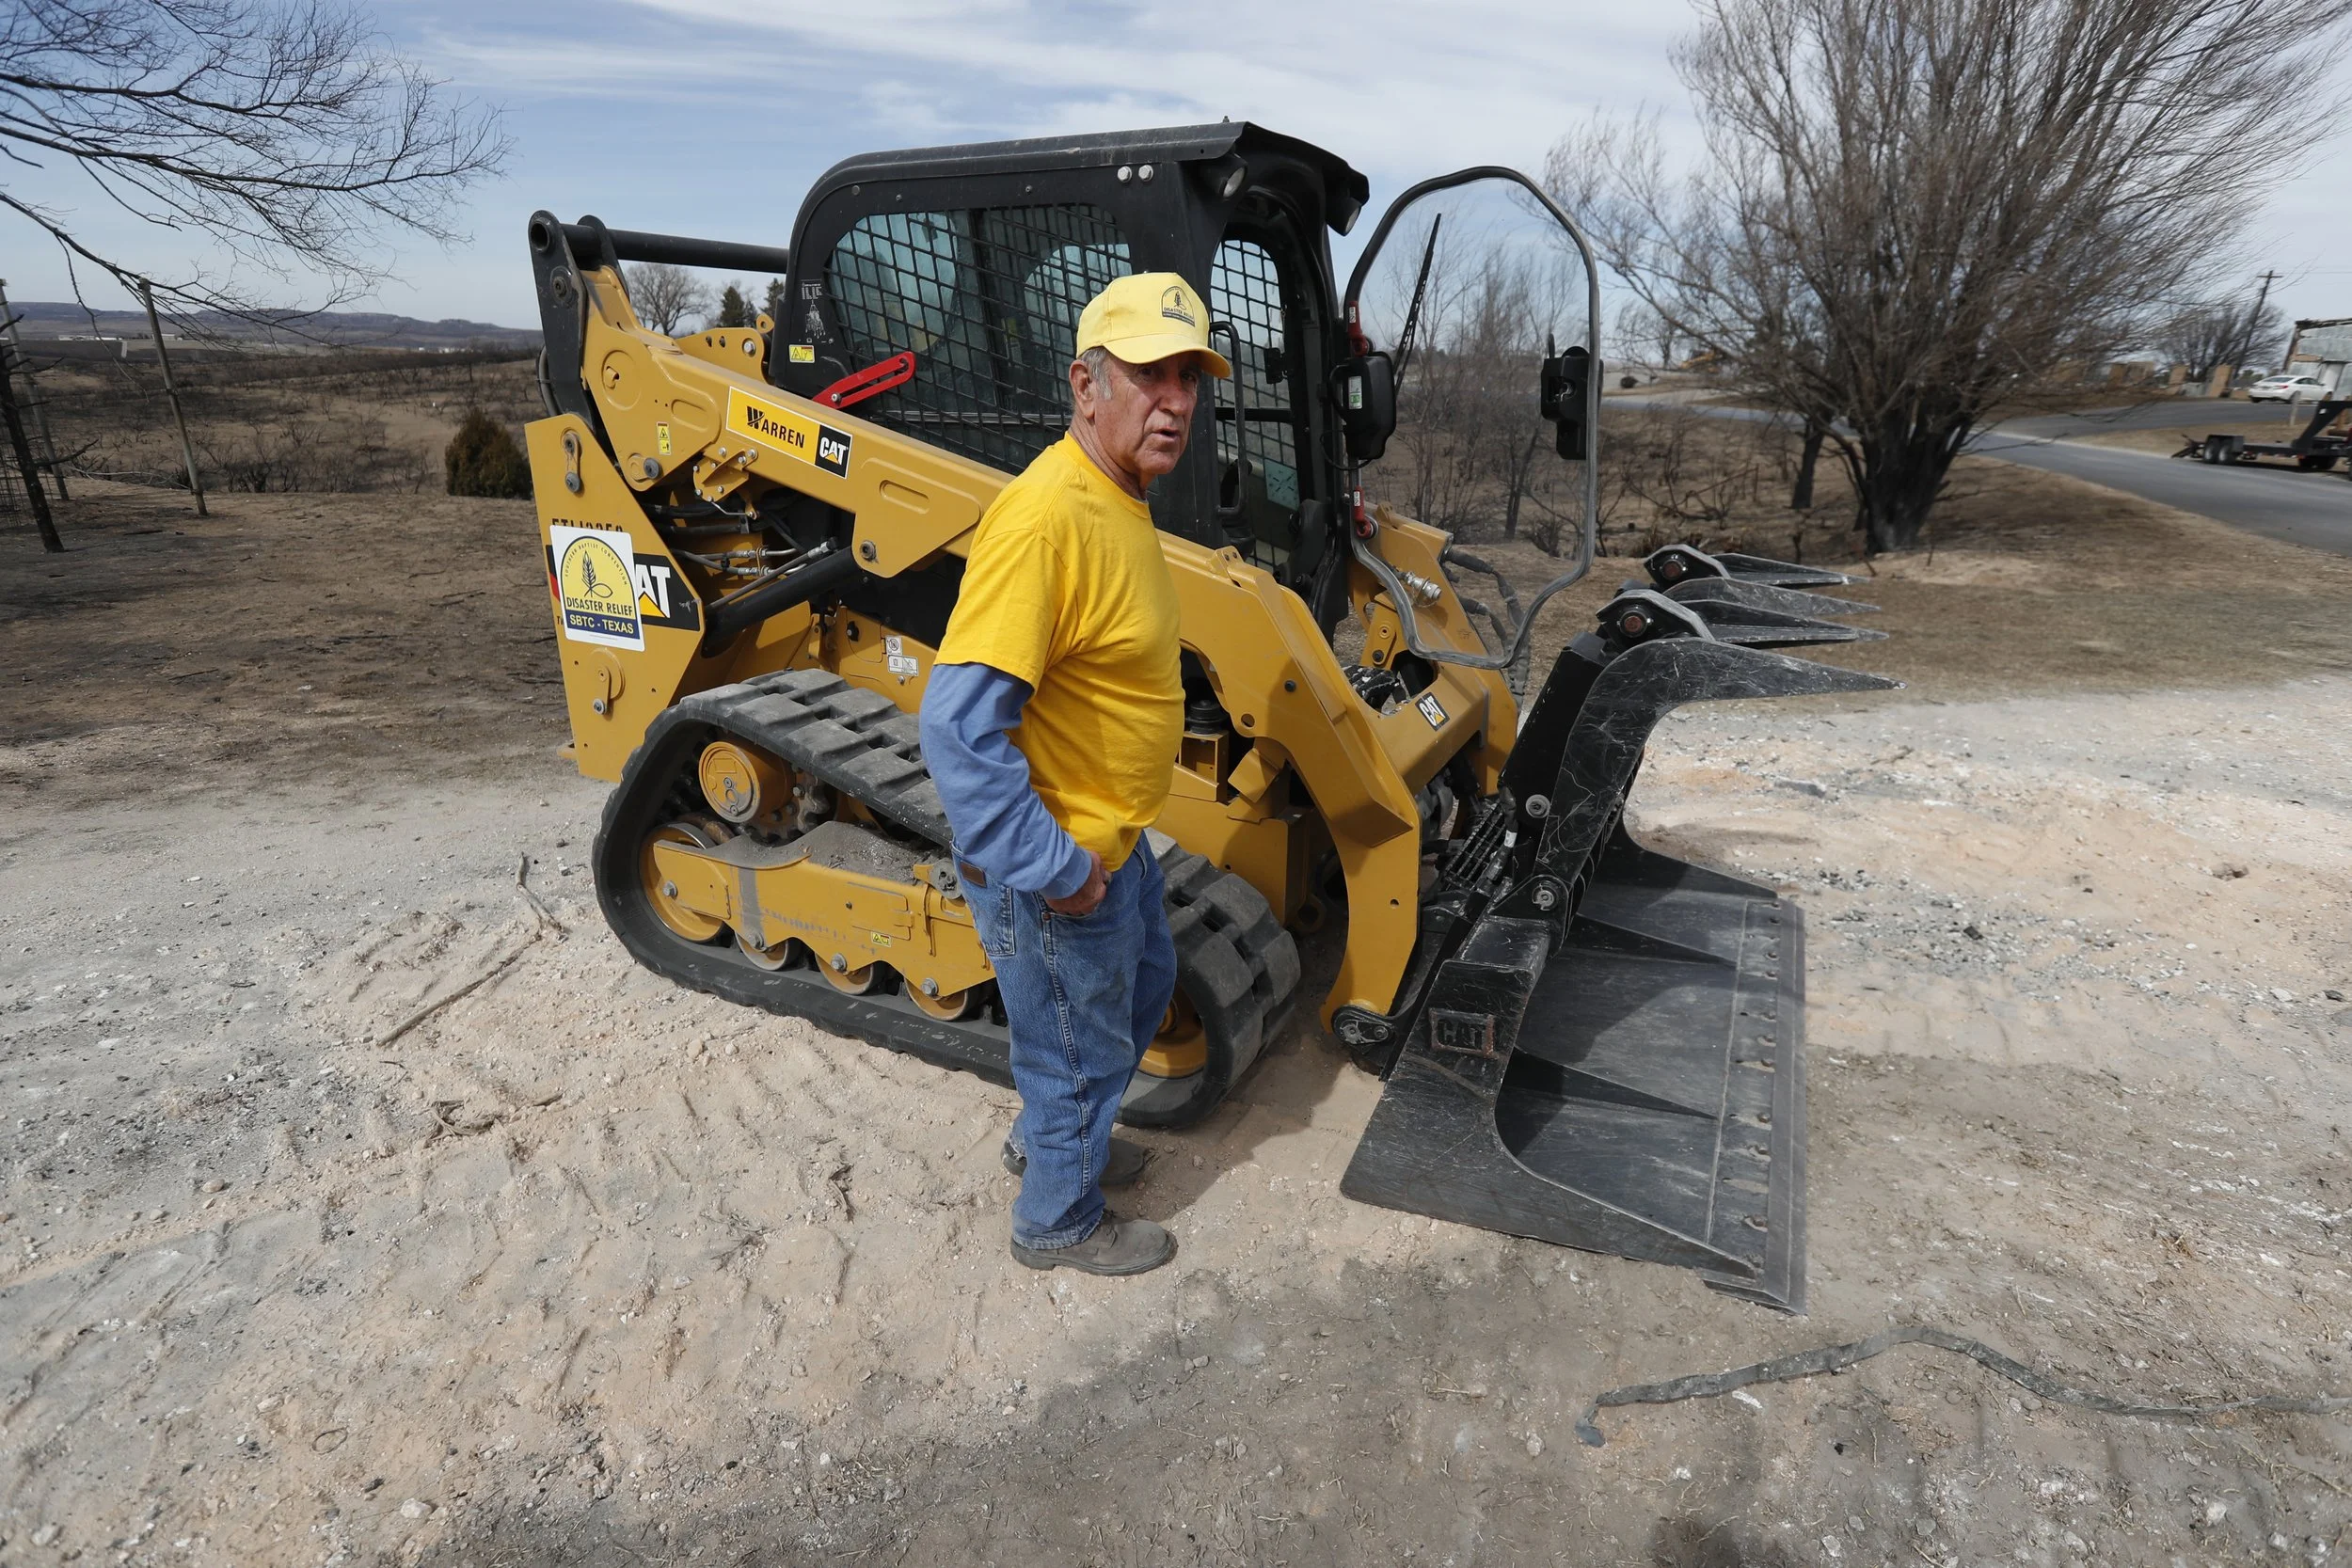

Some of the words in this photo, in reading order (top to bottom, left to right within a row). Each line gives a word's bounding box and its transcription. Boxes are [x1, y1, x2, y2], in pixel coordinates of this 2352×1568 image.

[746, 405, 805, 449] WARREN
[819, 436, 848, 466] CAT
[566, 596, 604, 612] DISASTER
[606, 602, 633, 616] RELIEF
[635, 563, 671, 619] AT
[569, 613, 595, 628] SBTC
[602, 619, 634, 635] TEXAS
[1419, 695, 1446, 726] CAT
[1437, 1019, 1486, 1051] CAT
